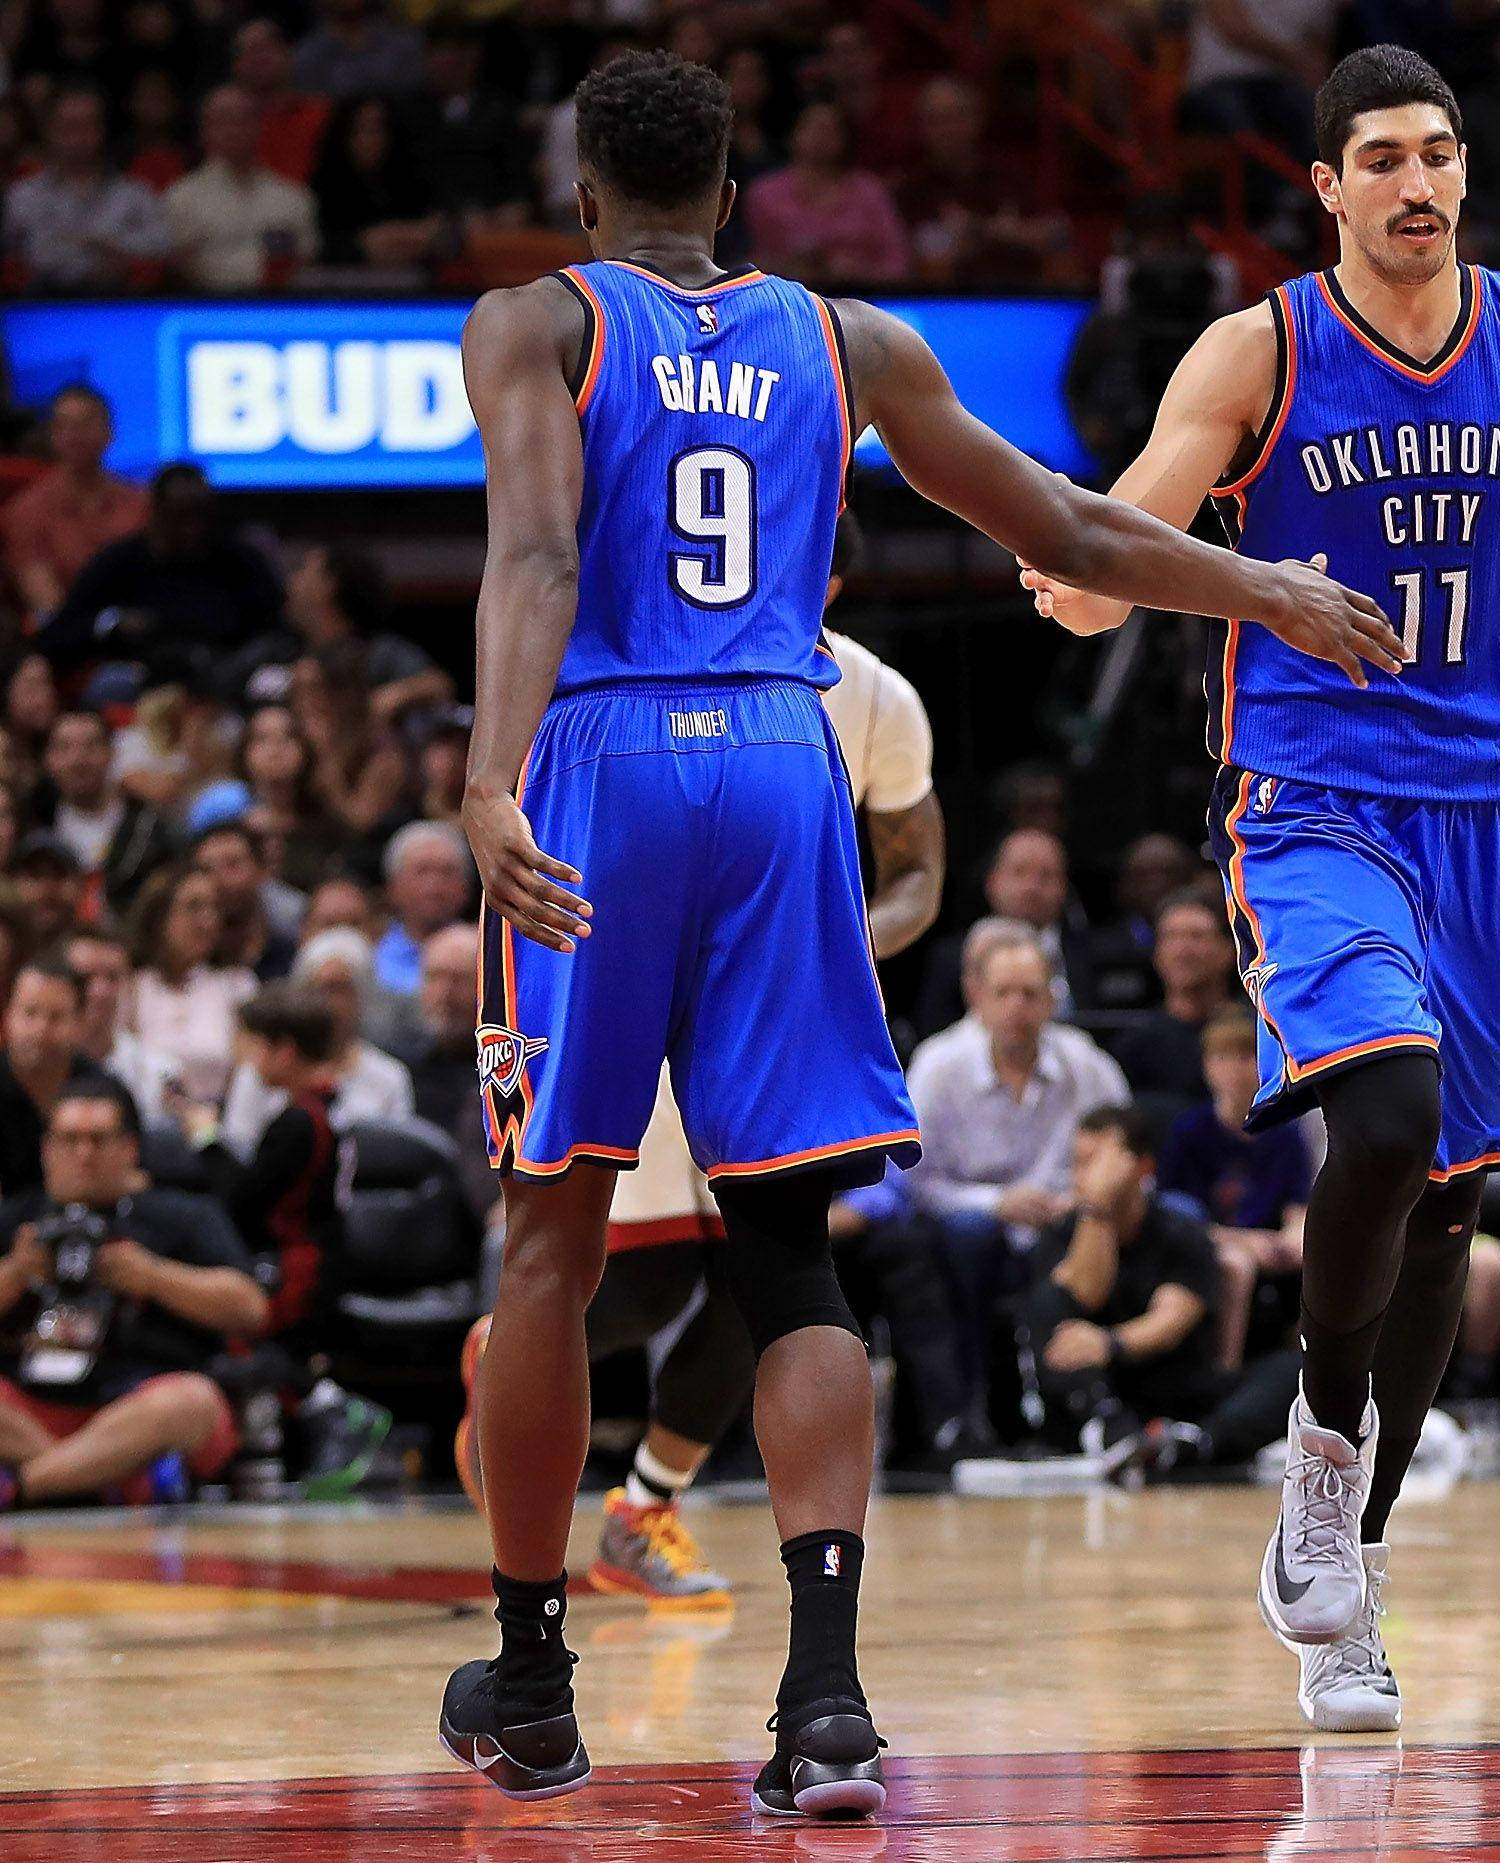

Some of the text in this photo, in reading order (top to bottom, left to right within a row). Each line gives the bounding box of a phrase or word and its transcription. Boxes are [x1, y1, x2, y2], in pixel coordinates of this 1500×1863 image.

[187, 340, 479, 453] BUD
[652, 354, 780, 422] GRANT
[669, 446, 757, 608] 9
[1382, 492, 1482, 545] CITY
[1393, 568, 1469, 665] 11
[668, 708, 728, 738] THUNDER
[482, 1040, 513, 1079] OKC
